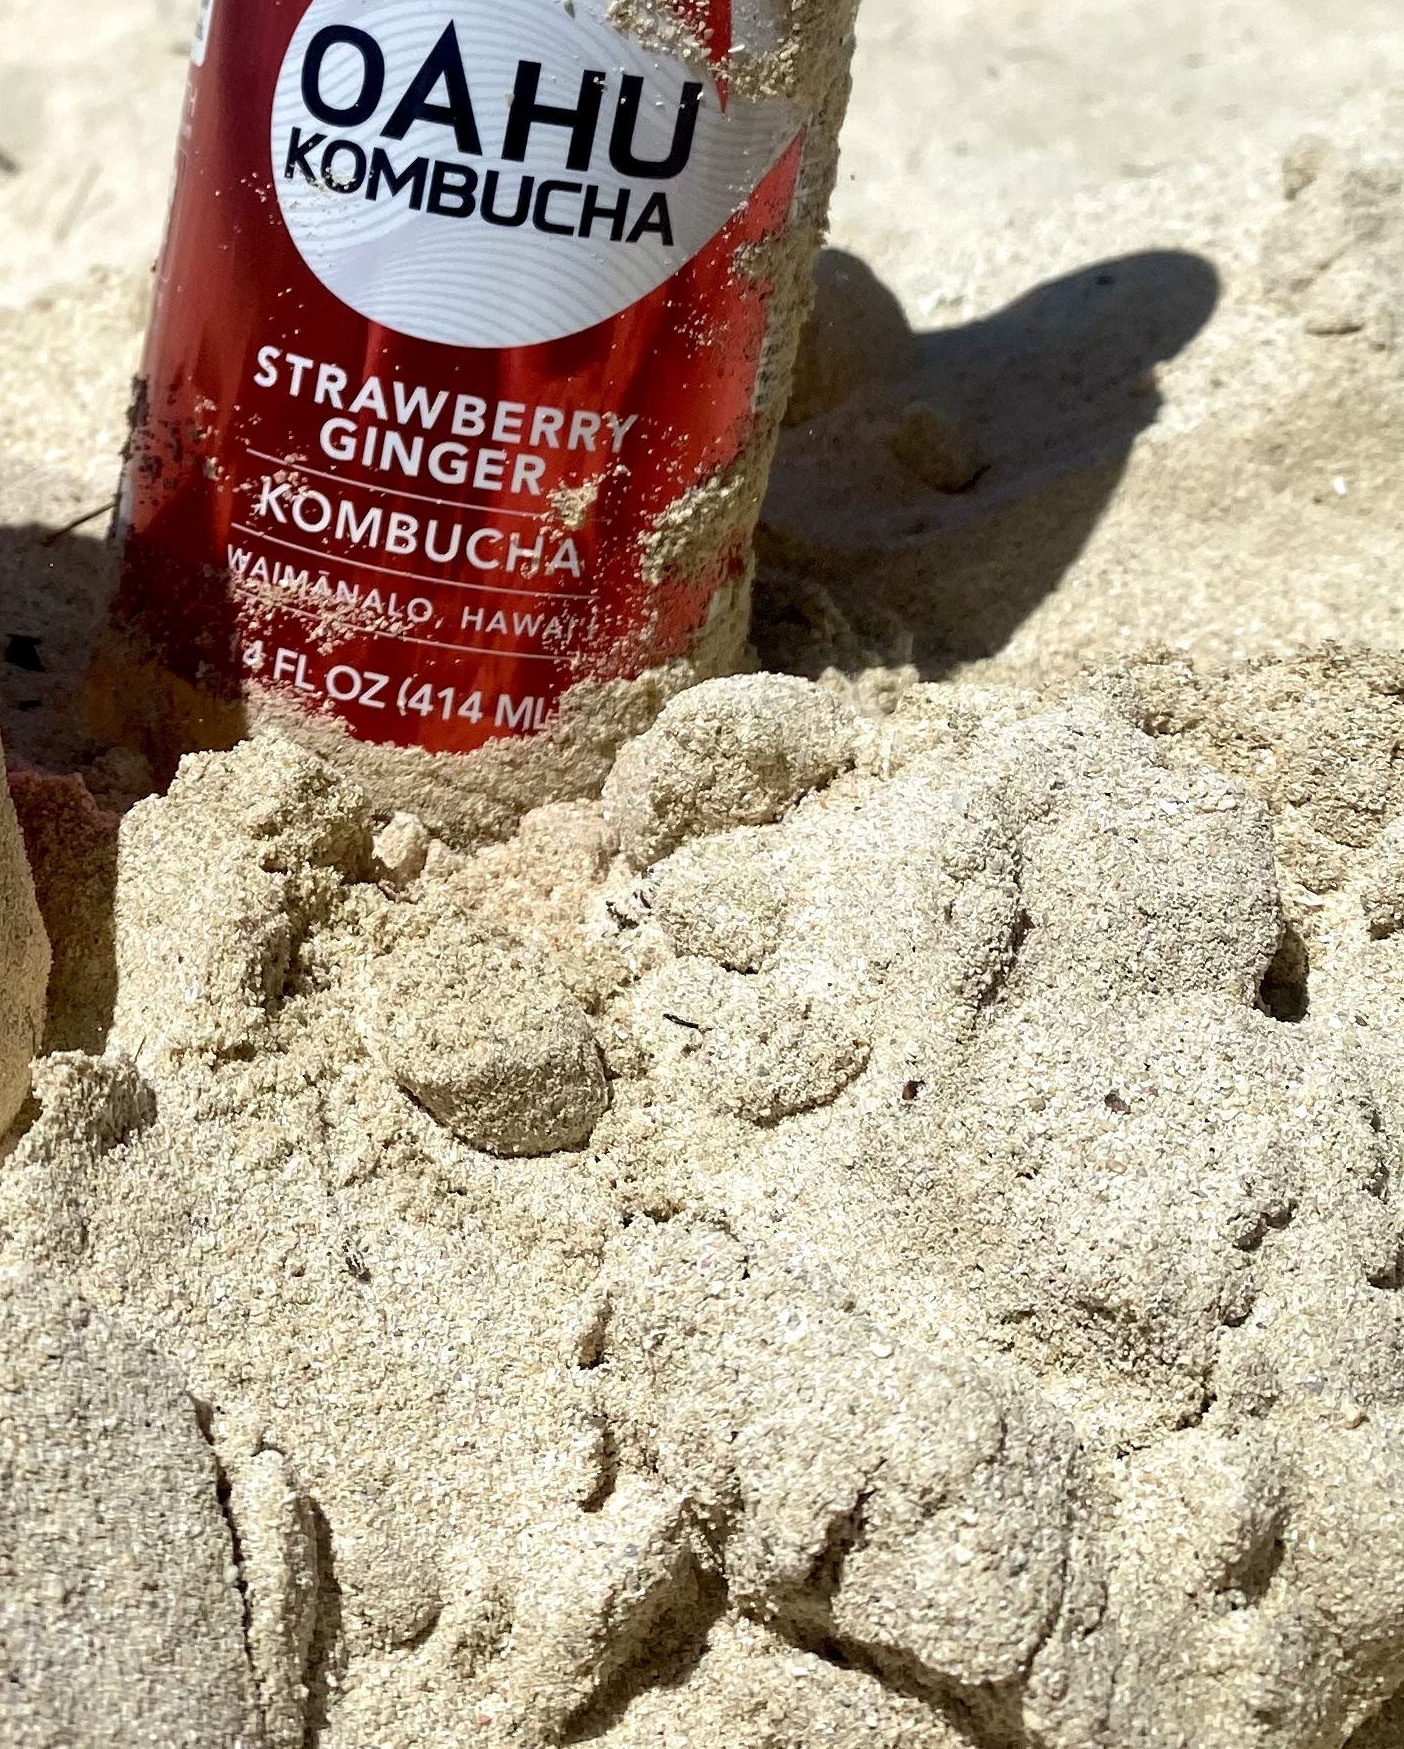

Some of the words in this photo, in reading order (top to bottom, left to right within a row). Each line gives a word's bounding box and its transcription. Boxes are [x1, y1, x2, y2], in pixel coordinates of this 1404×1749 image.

[300, 19, 703, 179] OAHU
[283, 127, 674, 247] KOMBUCHA
[253, 345, 639, 453] STRAWBERRY
[319, 417, 546, 496] GINGER
[259, 475, 581, 578] KOMBUCHA
[242, 640, 264, 667] 4
[273, 647, 315, 691] FL
[325, 664, 389, 709] OZ
[397, 676, 484, 725] (414
[494, 693, 549, 731] ML
